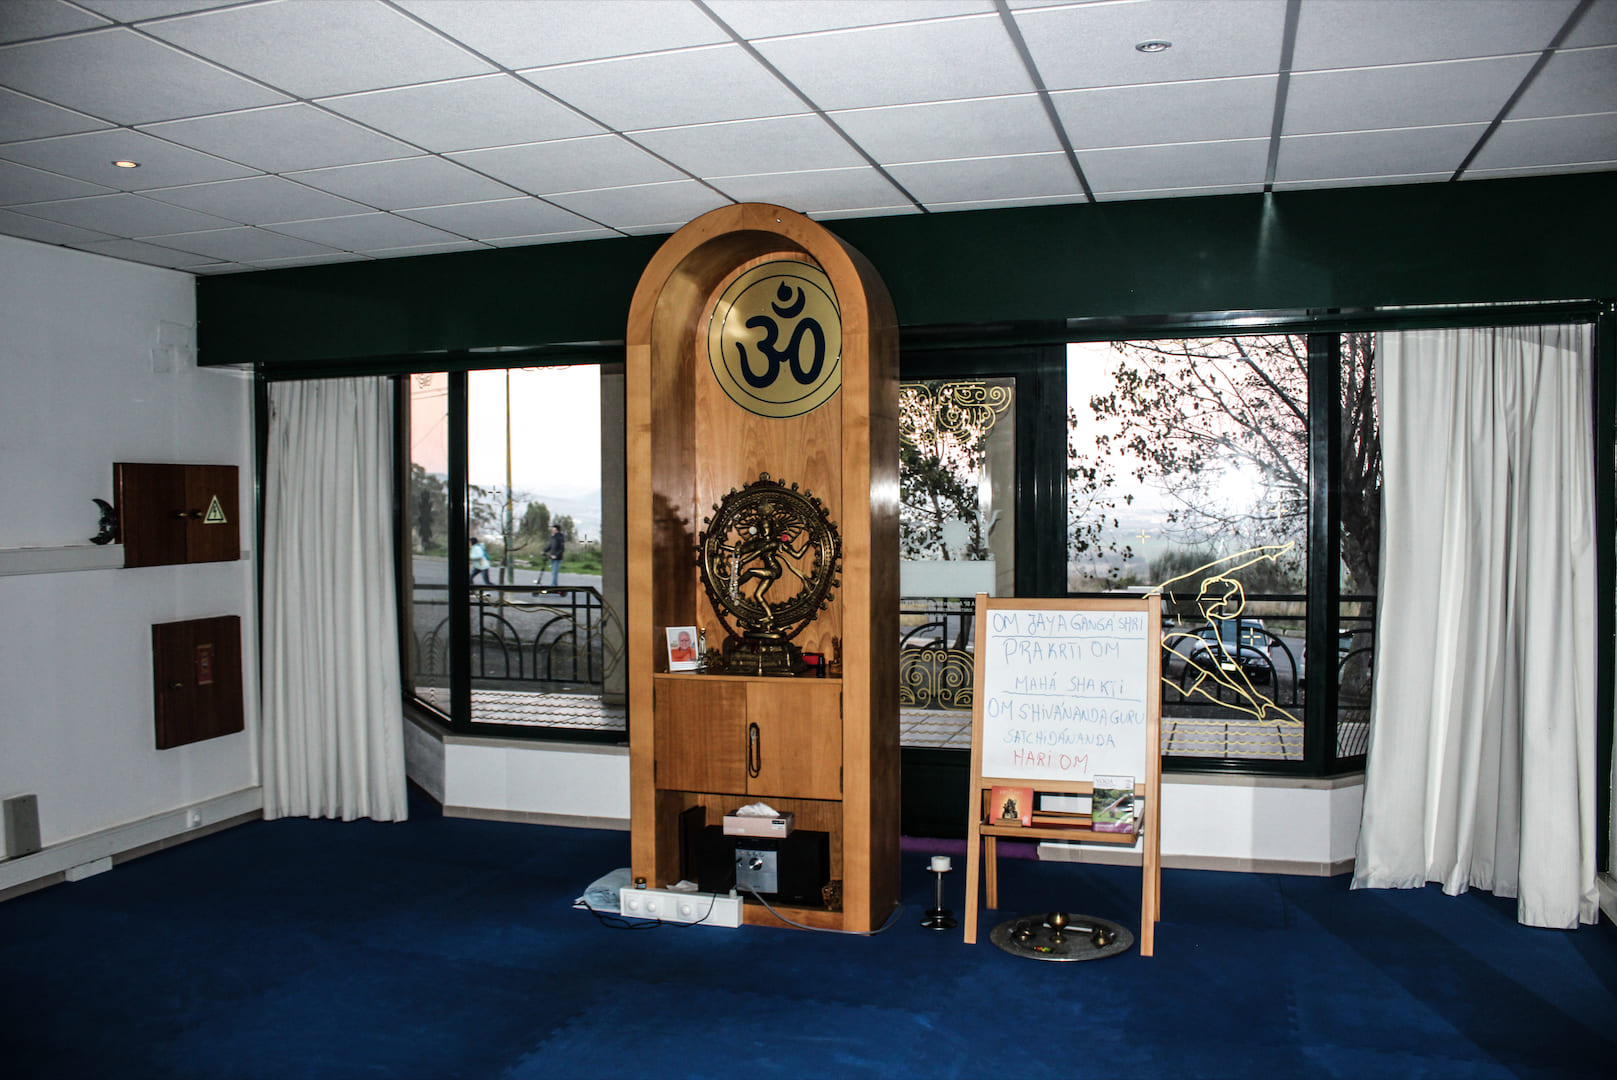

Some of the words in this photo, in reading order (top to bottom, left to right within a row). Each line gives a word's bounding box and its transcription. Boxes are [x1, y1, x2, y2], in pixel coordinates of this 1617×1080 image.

[993, 613, 1019, 633] OM
[1028, 612, 1068, 636] JAYA
[1090, 640, 1120, 660] OM
[1015, 672, 1057, 692] MAHÁ
[988, 697, 1013, 720] OM
[1109, 707, 1145, 725] GURU
[1059, 753, 1088, 774] OM
